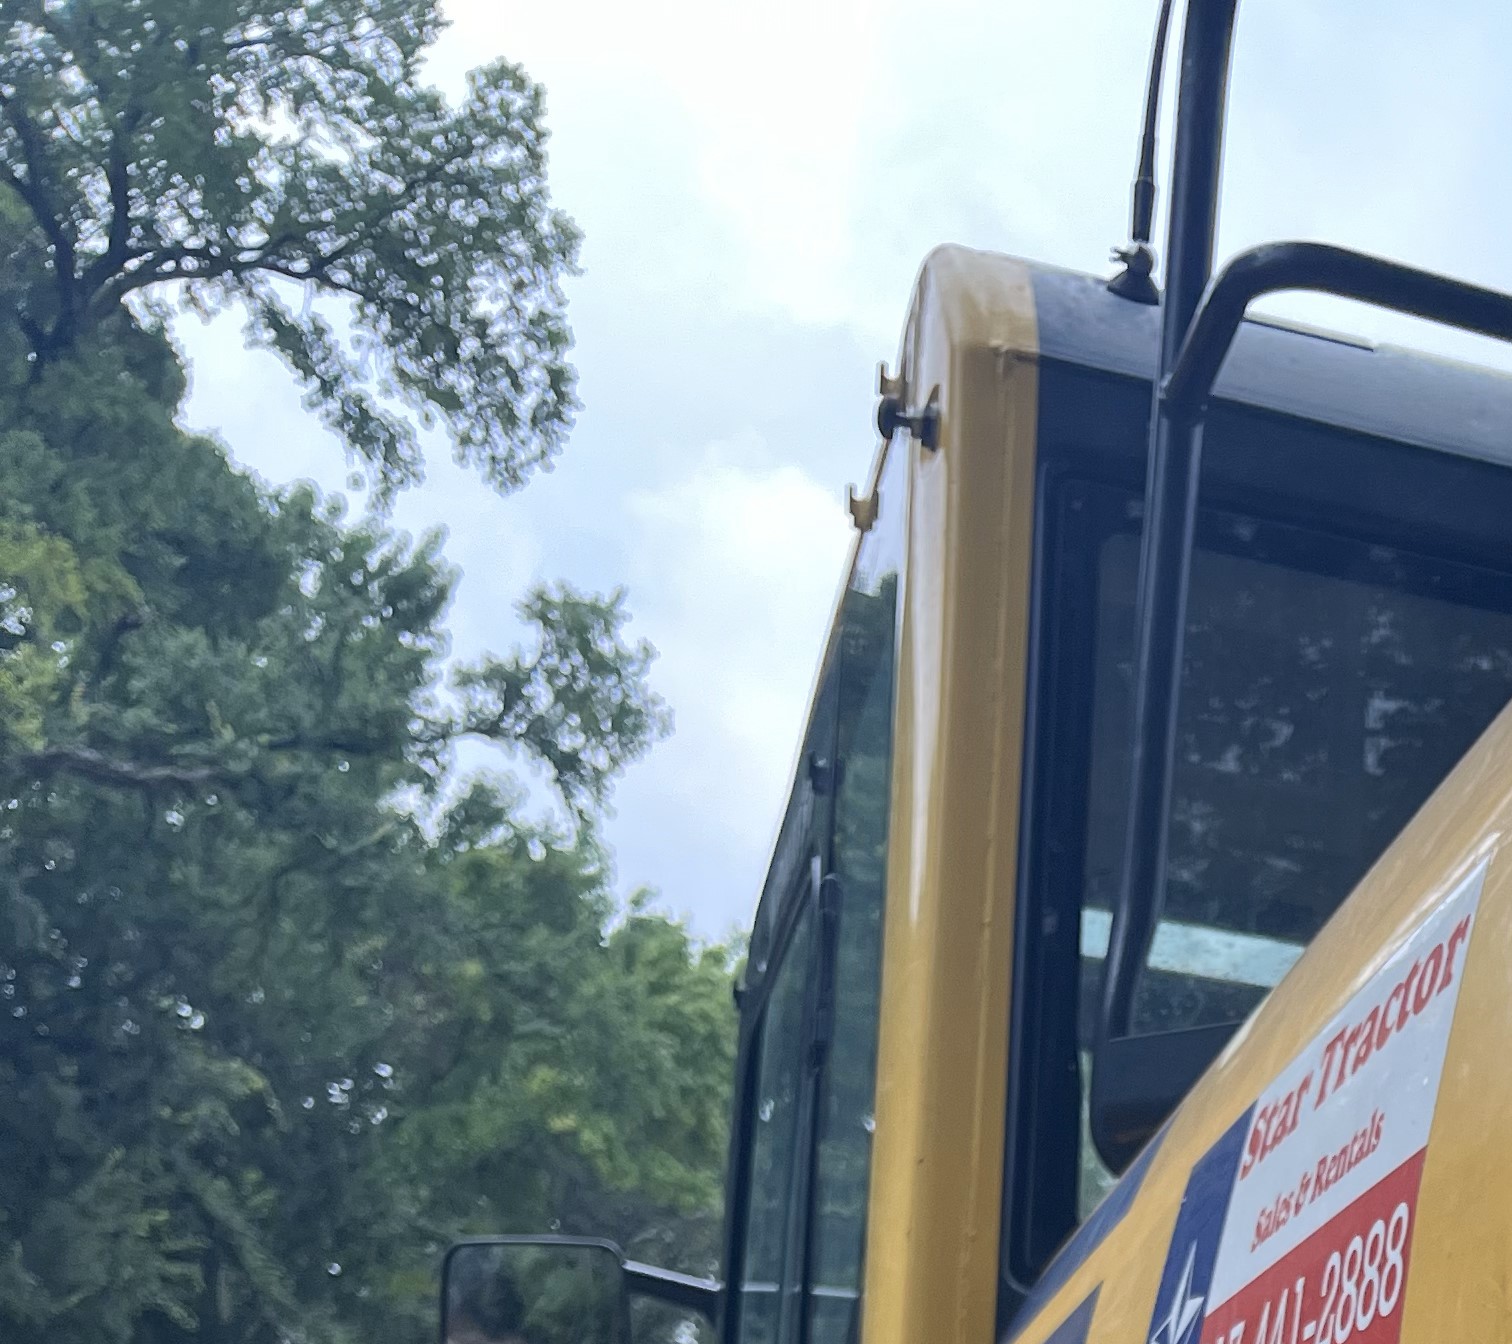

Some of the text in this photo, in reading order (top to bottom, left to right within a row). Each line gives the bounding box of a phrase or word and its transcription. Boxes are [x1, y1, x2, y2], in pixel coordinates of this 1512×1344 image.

[1239, 913, 1471, 1181] Star Tractor
[1251, 1192, 1295, 1253] Sales
[1309, 1107, 1386, 1204] Rentals
